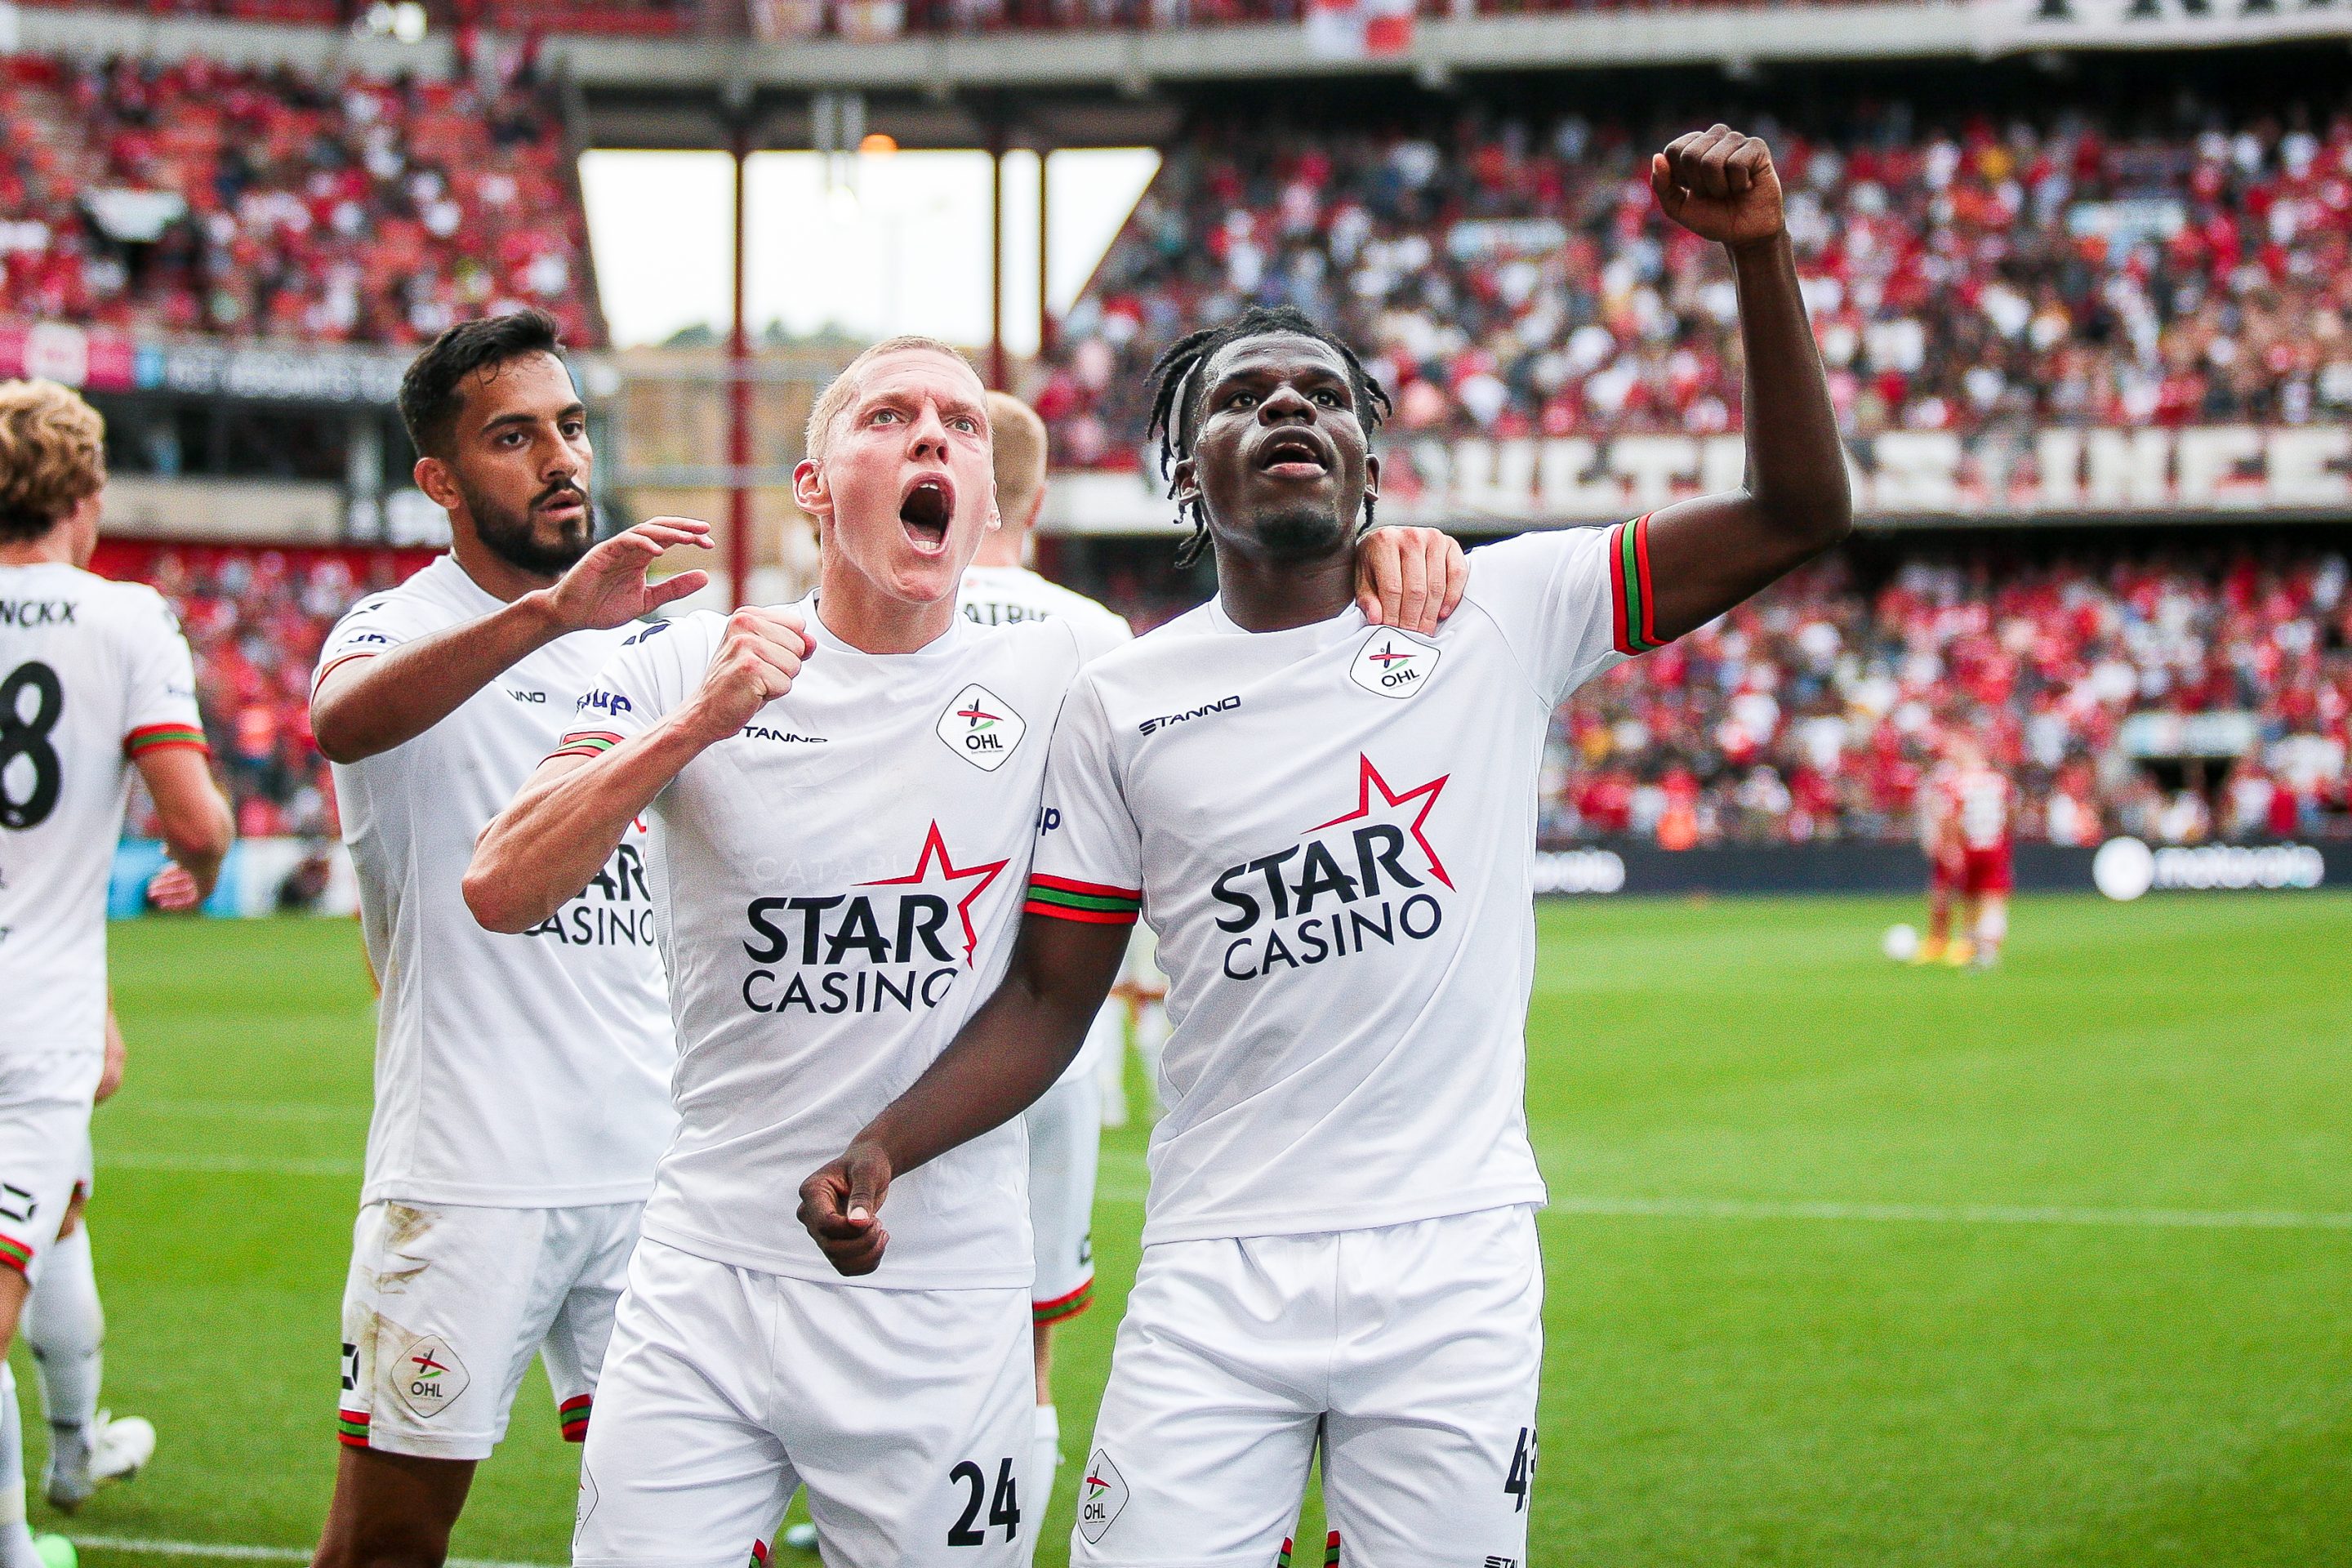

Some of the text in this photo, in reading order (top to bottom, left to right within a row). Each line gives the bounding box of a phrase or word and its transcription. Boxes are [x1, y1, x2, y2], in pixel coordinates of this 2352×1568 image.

[1382, 669, 1420, 687] OHL
[1138, 695, 1241, 737] STANNO
[965, 733, 1004, 750] OHL
[1211, 824, 1425, 933] STAR
[523, 906, 653, 947] ASINO
[742, 893, 956, 964] STAR
[1223, 893, 1442, 981] CASINO
[742, 968, 959, 1014] CASINO
[411, 1381, 443, 1397] OHL
[947, 1458, 1020, 1547] 24
[1084, 1503, 1106, 1520] OHL
